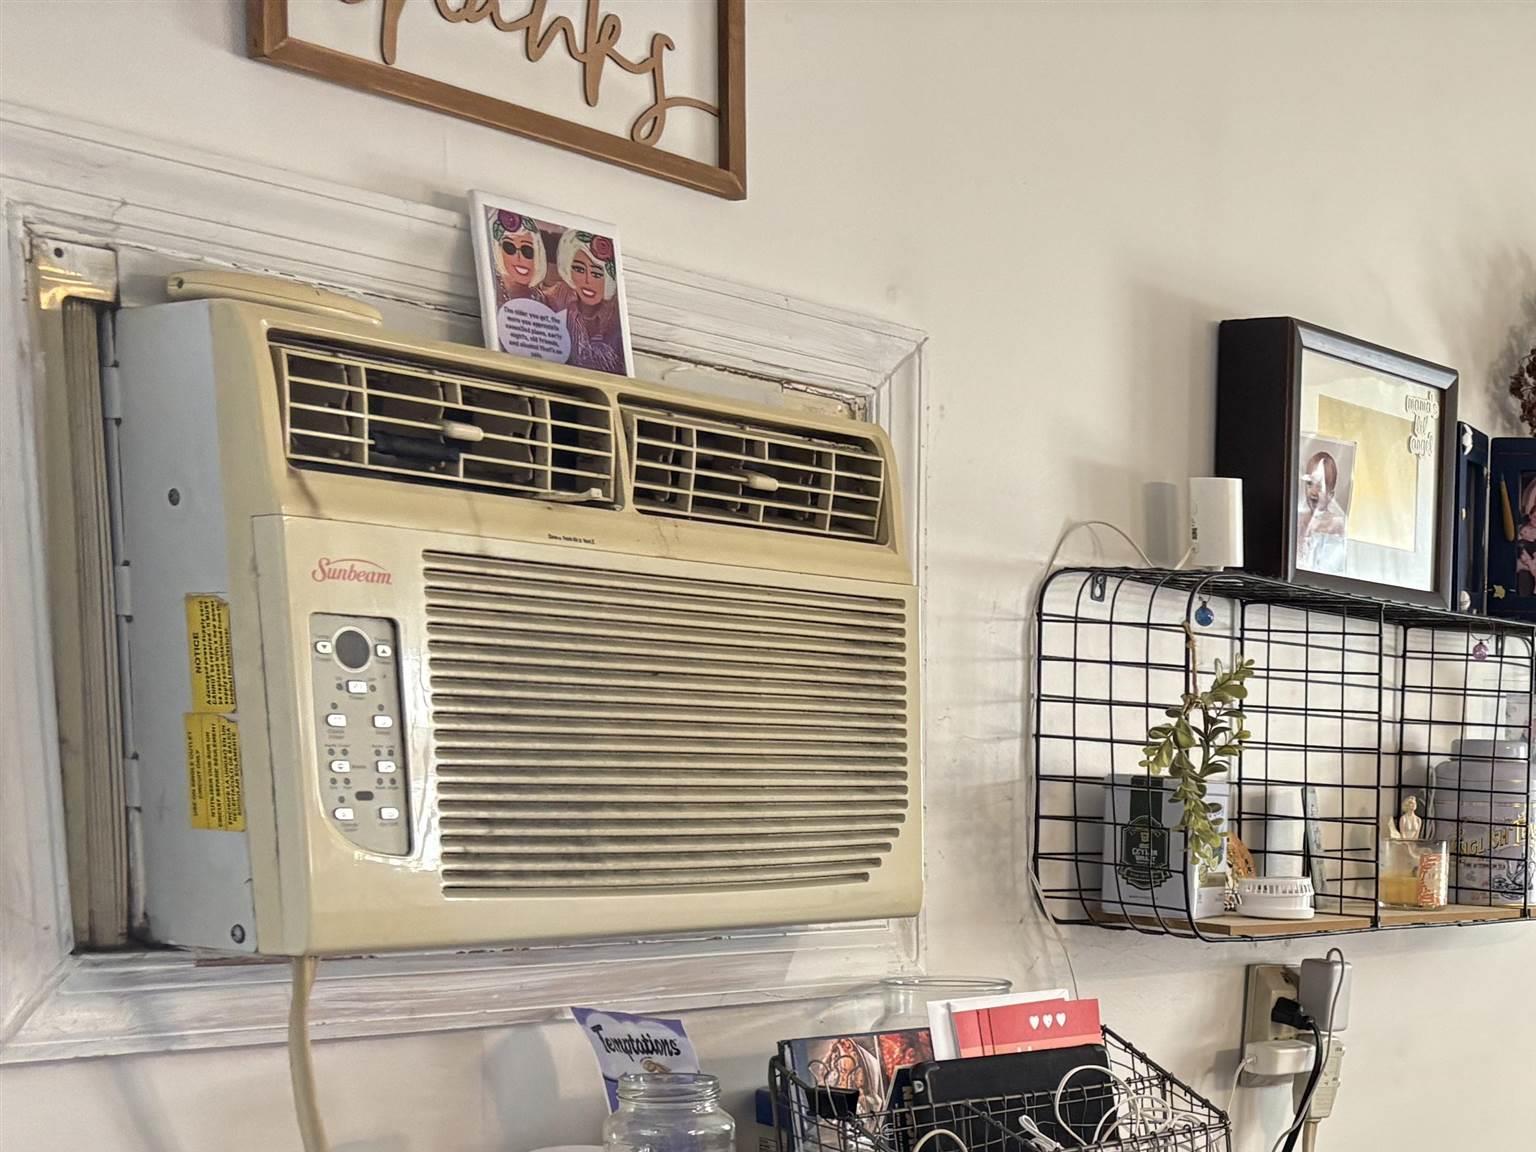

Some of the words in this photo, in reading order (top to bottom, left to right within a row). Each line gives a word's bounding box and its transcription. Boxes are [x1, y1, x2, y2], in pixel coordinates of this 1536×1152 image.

[338, 0, 719, 146] nks
[312, 557, 393, 585] Sunbeam
[192, 632, 202, 674] NOTICE
[590, 1024, 682, 1062] Temptations
